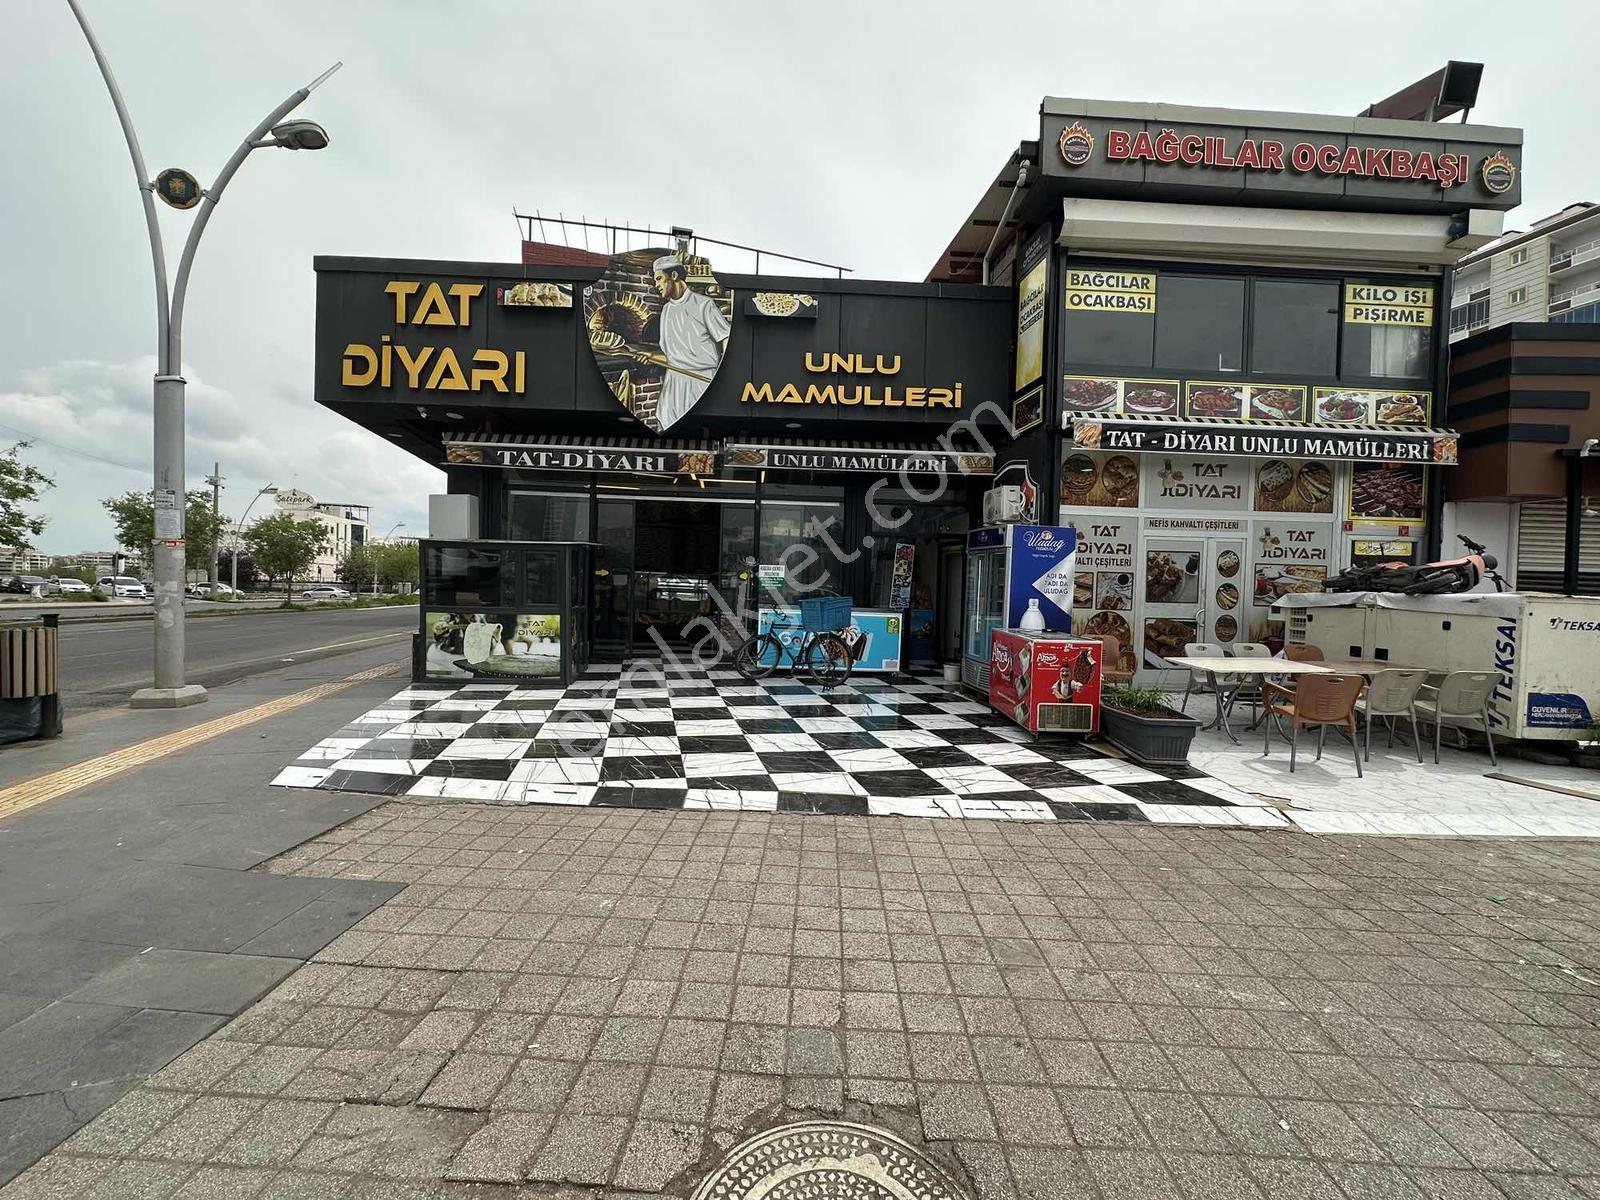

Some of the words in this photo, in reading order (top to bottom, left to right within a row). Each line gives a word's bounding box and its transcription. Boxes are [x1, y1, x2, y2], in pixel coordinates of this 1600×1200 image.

[1107, 128, 1286, 170] BAĞCILAR
[1291, 142, 1470, 188] OCAKBAŞI
[1070, 273, 1150, 290] BAĞCILAR
[384, 281, 485, 327] TAT
[1069, 293, 1152, 310] OCAKBAŞI
[342, 335, 526, 393] DİYARI
[805, 352, 901, 375] UNLU
[740, 381, 963, 409] MAMULLERİ
[1107, 430, 1146, 448] TAT
[1163, 430, 1235, 451] DİYARI
[1242, 435, 1298, 454] UNLU
[1303, 438, 1430, 460] MAMÜLLERİ
[497, 449, 667, 472] TAT-DİYARI
[773, 454, 826, 468] UNLU
[831, 455, 949, 472] MAMÜLLERİ
[1192, 463, 1228, 477] TAT
[1091, 525, 1121, 537] TAT
[1170, 519, 1204, 529] KAHVALTI
[1287, 530, 1316, 542] TAT
[1492, 616, 1517, 703] TEKSA
